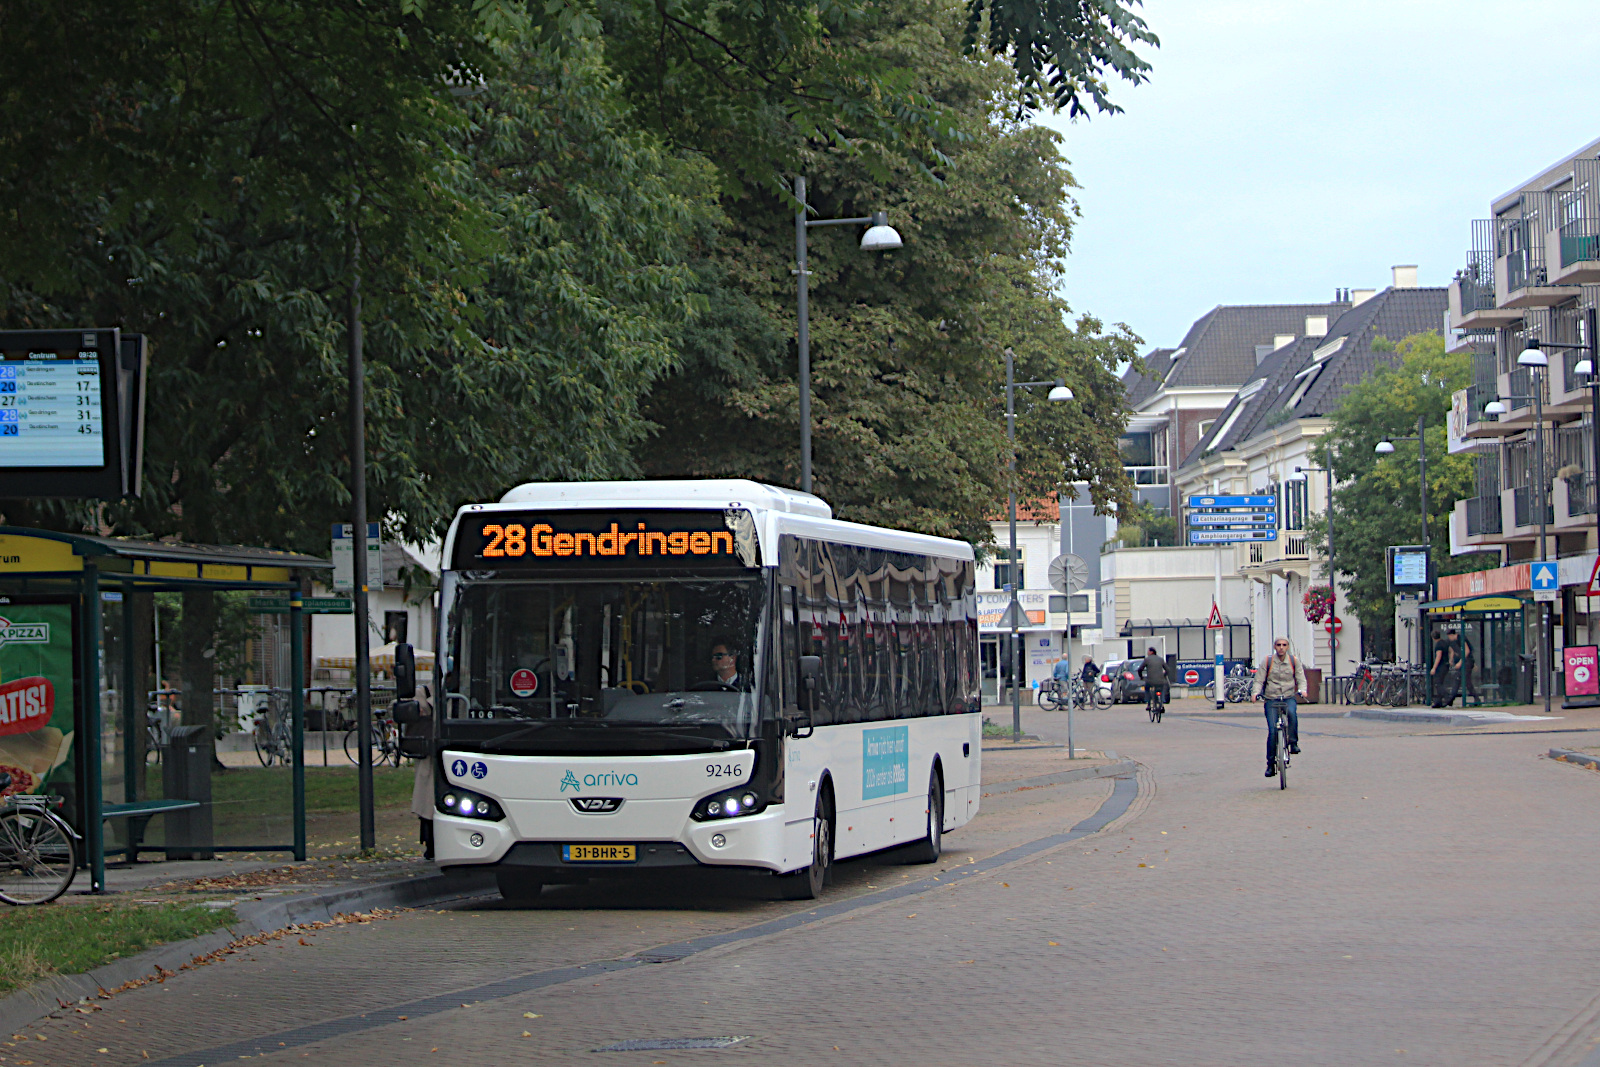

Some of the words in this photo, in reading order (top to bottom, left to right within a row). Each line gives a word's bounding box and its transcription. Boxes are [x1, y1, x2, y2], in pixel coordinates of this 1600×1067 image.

[0, 367, 14, 378] 28
[1, 381, 16, 392] 20
[76, 381, 90, 391] 17
[2, 395, 16, 406] 27
[76, 395, 90, 406] 31
[2, 409, 17, 420] 28
[77, 410, 91, 420] 31
[3, 424, 18, 435] 20
[78, 424, 92, 434] 45
[1200, 515, 1248, 523] Catharinagarage
[482, 524, 527, 557] 28
[531, 522, 734, 556] Gendringen
[8, 628, 44, 638] PIZZA
[1569, 656, 1594, 666] OPEN
[0, 684, 46, 724] ATIS!
[470, 710, 493, 718] 106
[706, 764, 742, 777] 9246
[584, 770, 638, 786] arriva
[577, 800, 614, 809] VDL
[575, 847, 630, 858] 31-BHR-5
